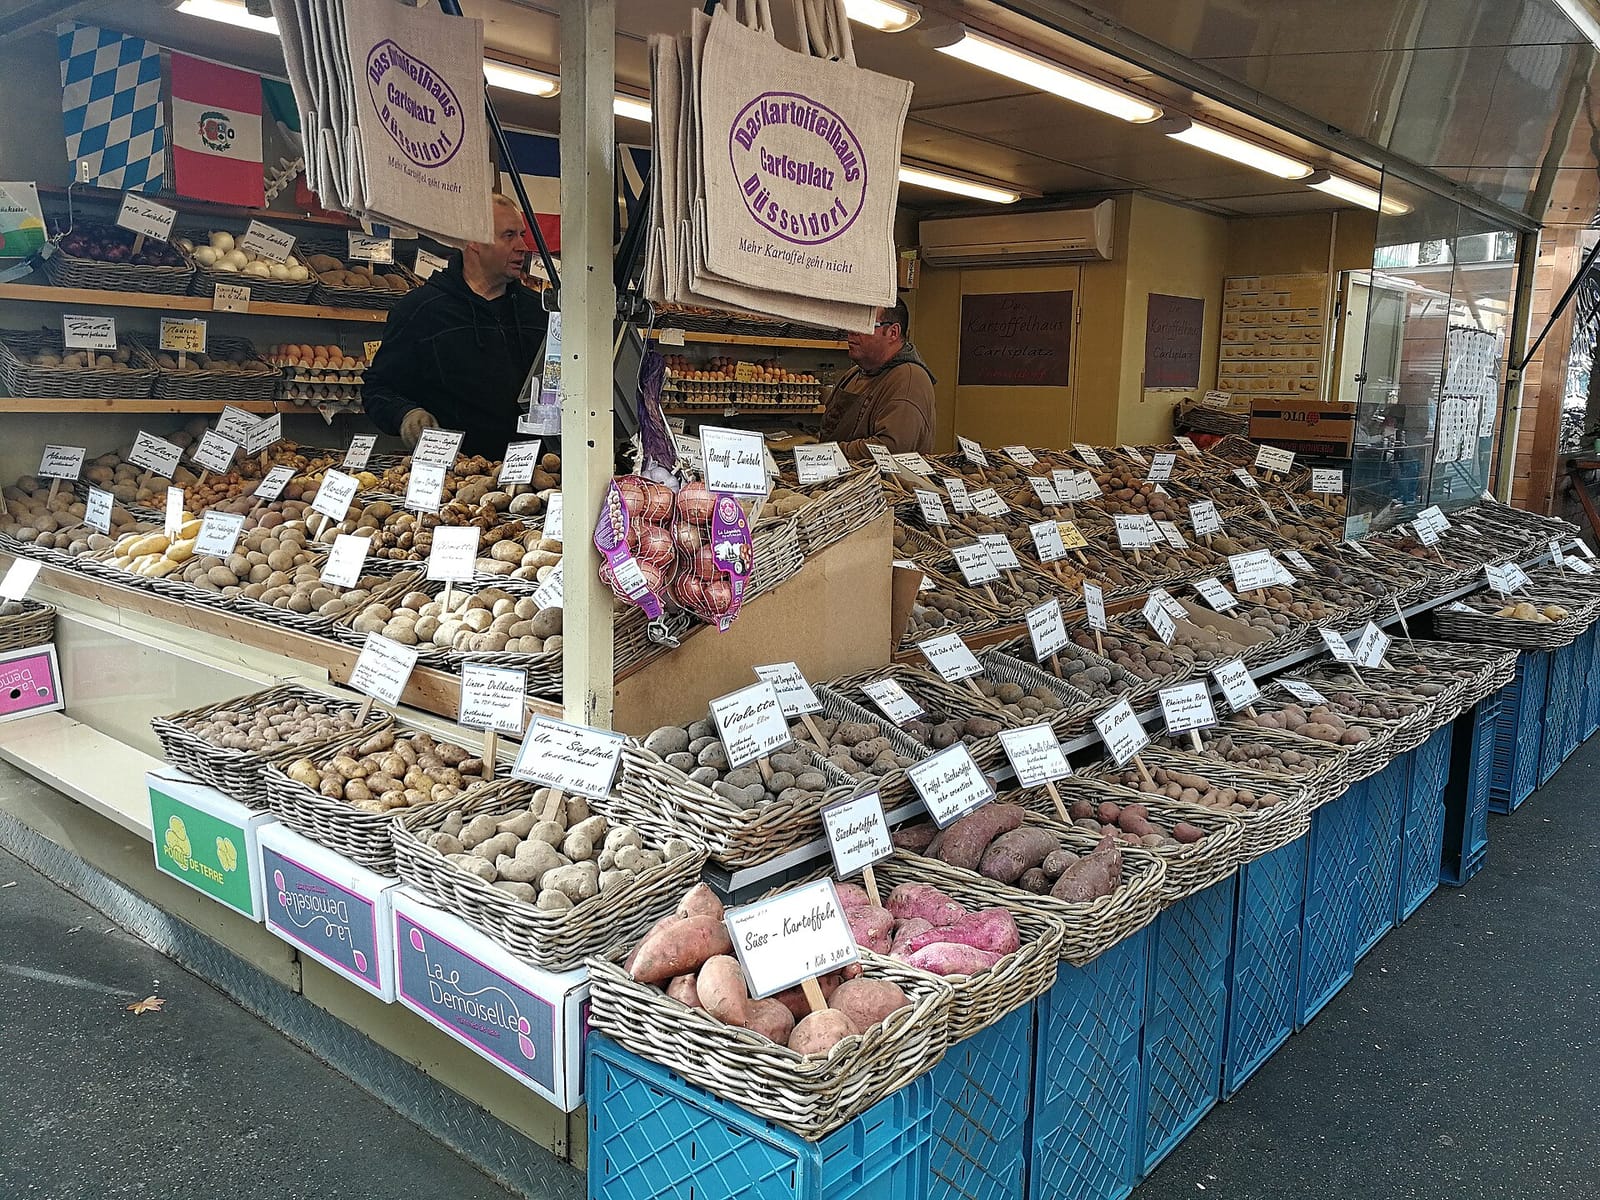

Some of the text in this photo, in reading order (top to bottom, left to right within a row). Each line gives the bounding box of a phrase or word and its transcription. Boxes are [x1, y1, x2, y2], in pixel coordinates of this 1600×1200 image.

[760, 146, 835, 191] Carlsplatz
[441, 182, 462, 194] nicht
[743, 173, 849, 236] Düsseldorf
[738, 237, 853, 274] Mehr Kartoffel geht nicht
[506, 452, 534, 463] Linda
[1222, 670, 1246, 687] Rooster
[723, 699, 776, 729] Violetta
[1104, 710, 1131, 734] La Ratte
[534, 733, 552, 745] Ur
[566, 741, 614, 760] Sieglinde
[163, 844, 225, 885] POMME DE TERRE
[285, 891, 349, 924] Demoiselle
[744, 931, 769, 951] Süss
[783, 901, 836, 937] Kartoffeln
[424, 953, 445, 981] La
[814, 953, 827, 967] Kilo
[845, 945, 850, 955] €
[429, 980, 519, 1032] Demoiselle
